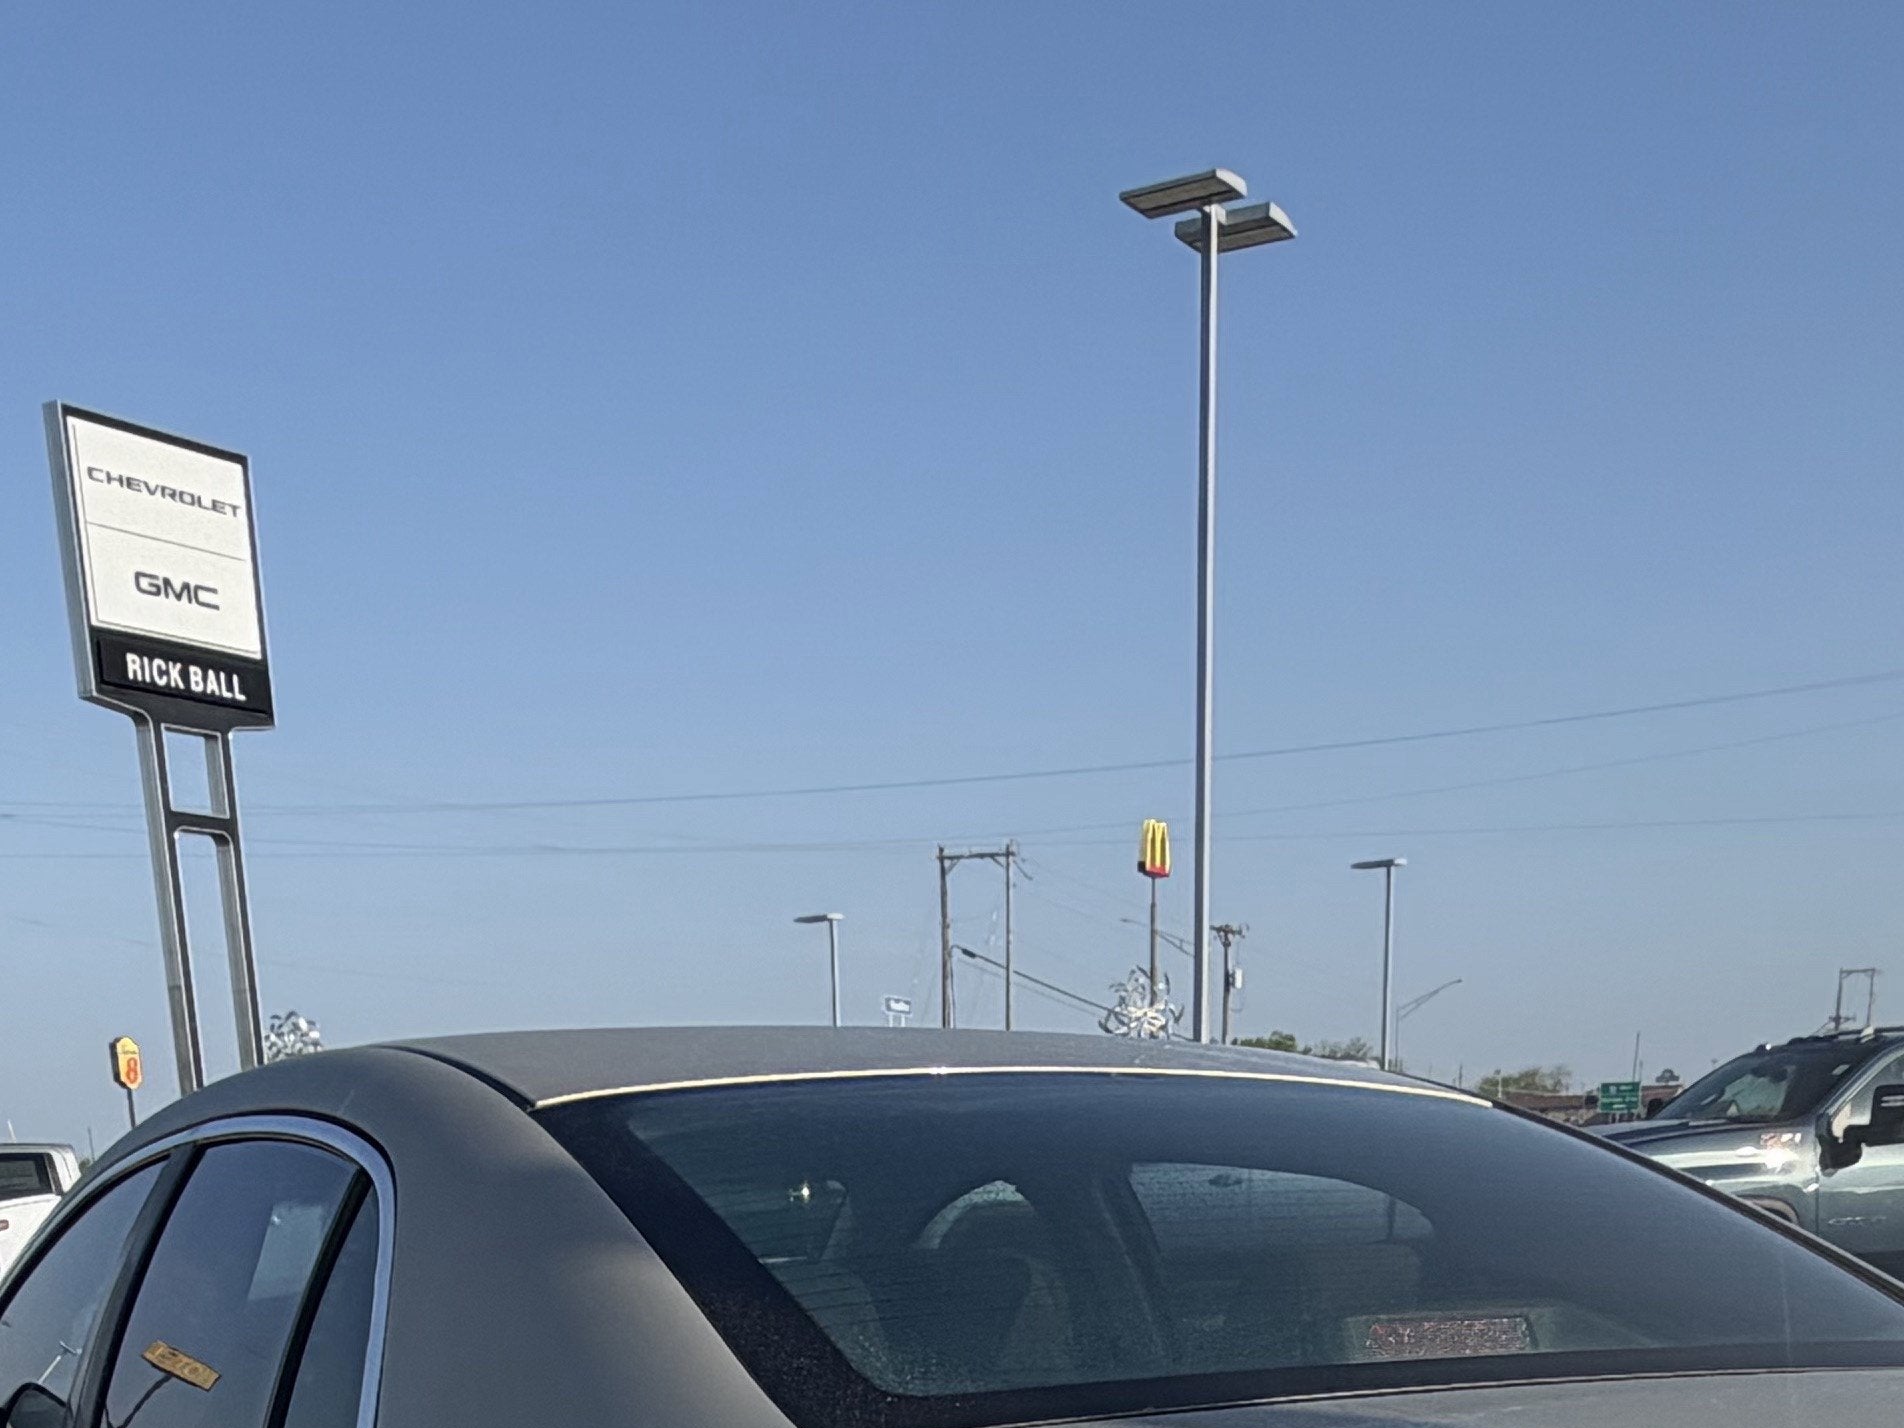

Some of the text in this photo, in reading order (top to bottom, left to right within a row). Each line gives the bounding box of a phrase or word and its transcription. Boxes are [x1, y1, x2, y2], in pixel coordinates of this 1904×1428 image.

[86, 465, 243, 518] CHEVROLET
[134, 570, 220, 611] GMC
[125, 651, 247, 701] RICK BALL
